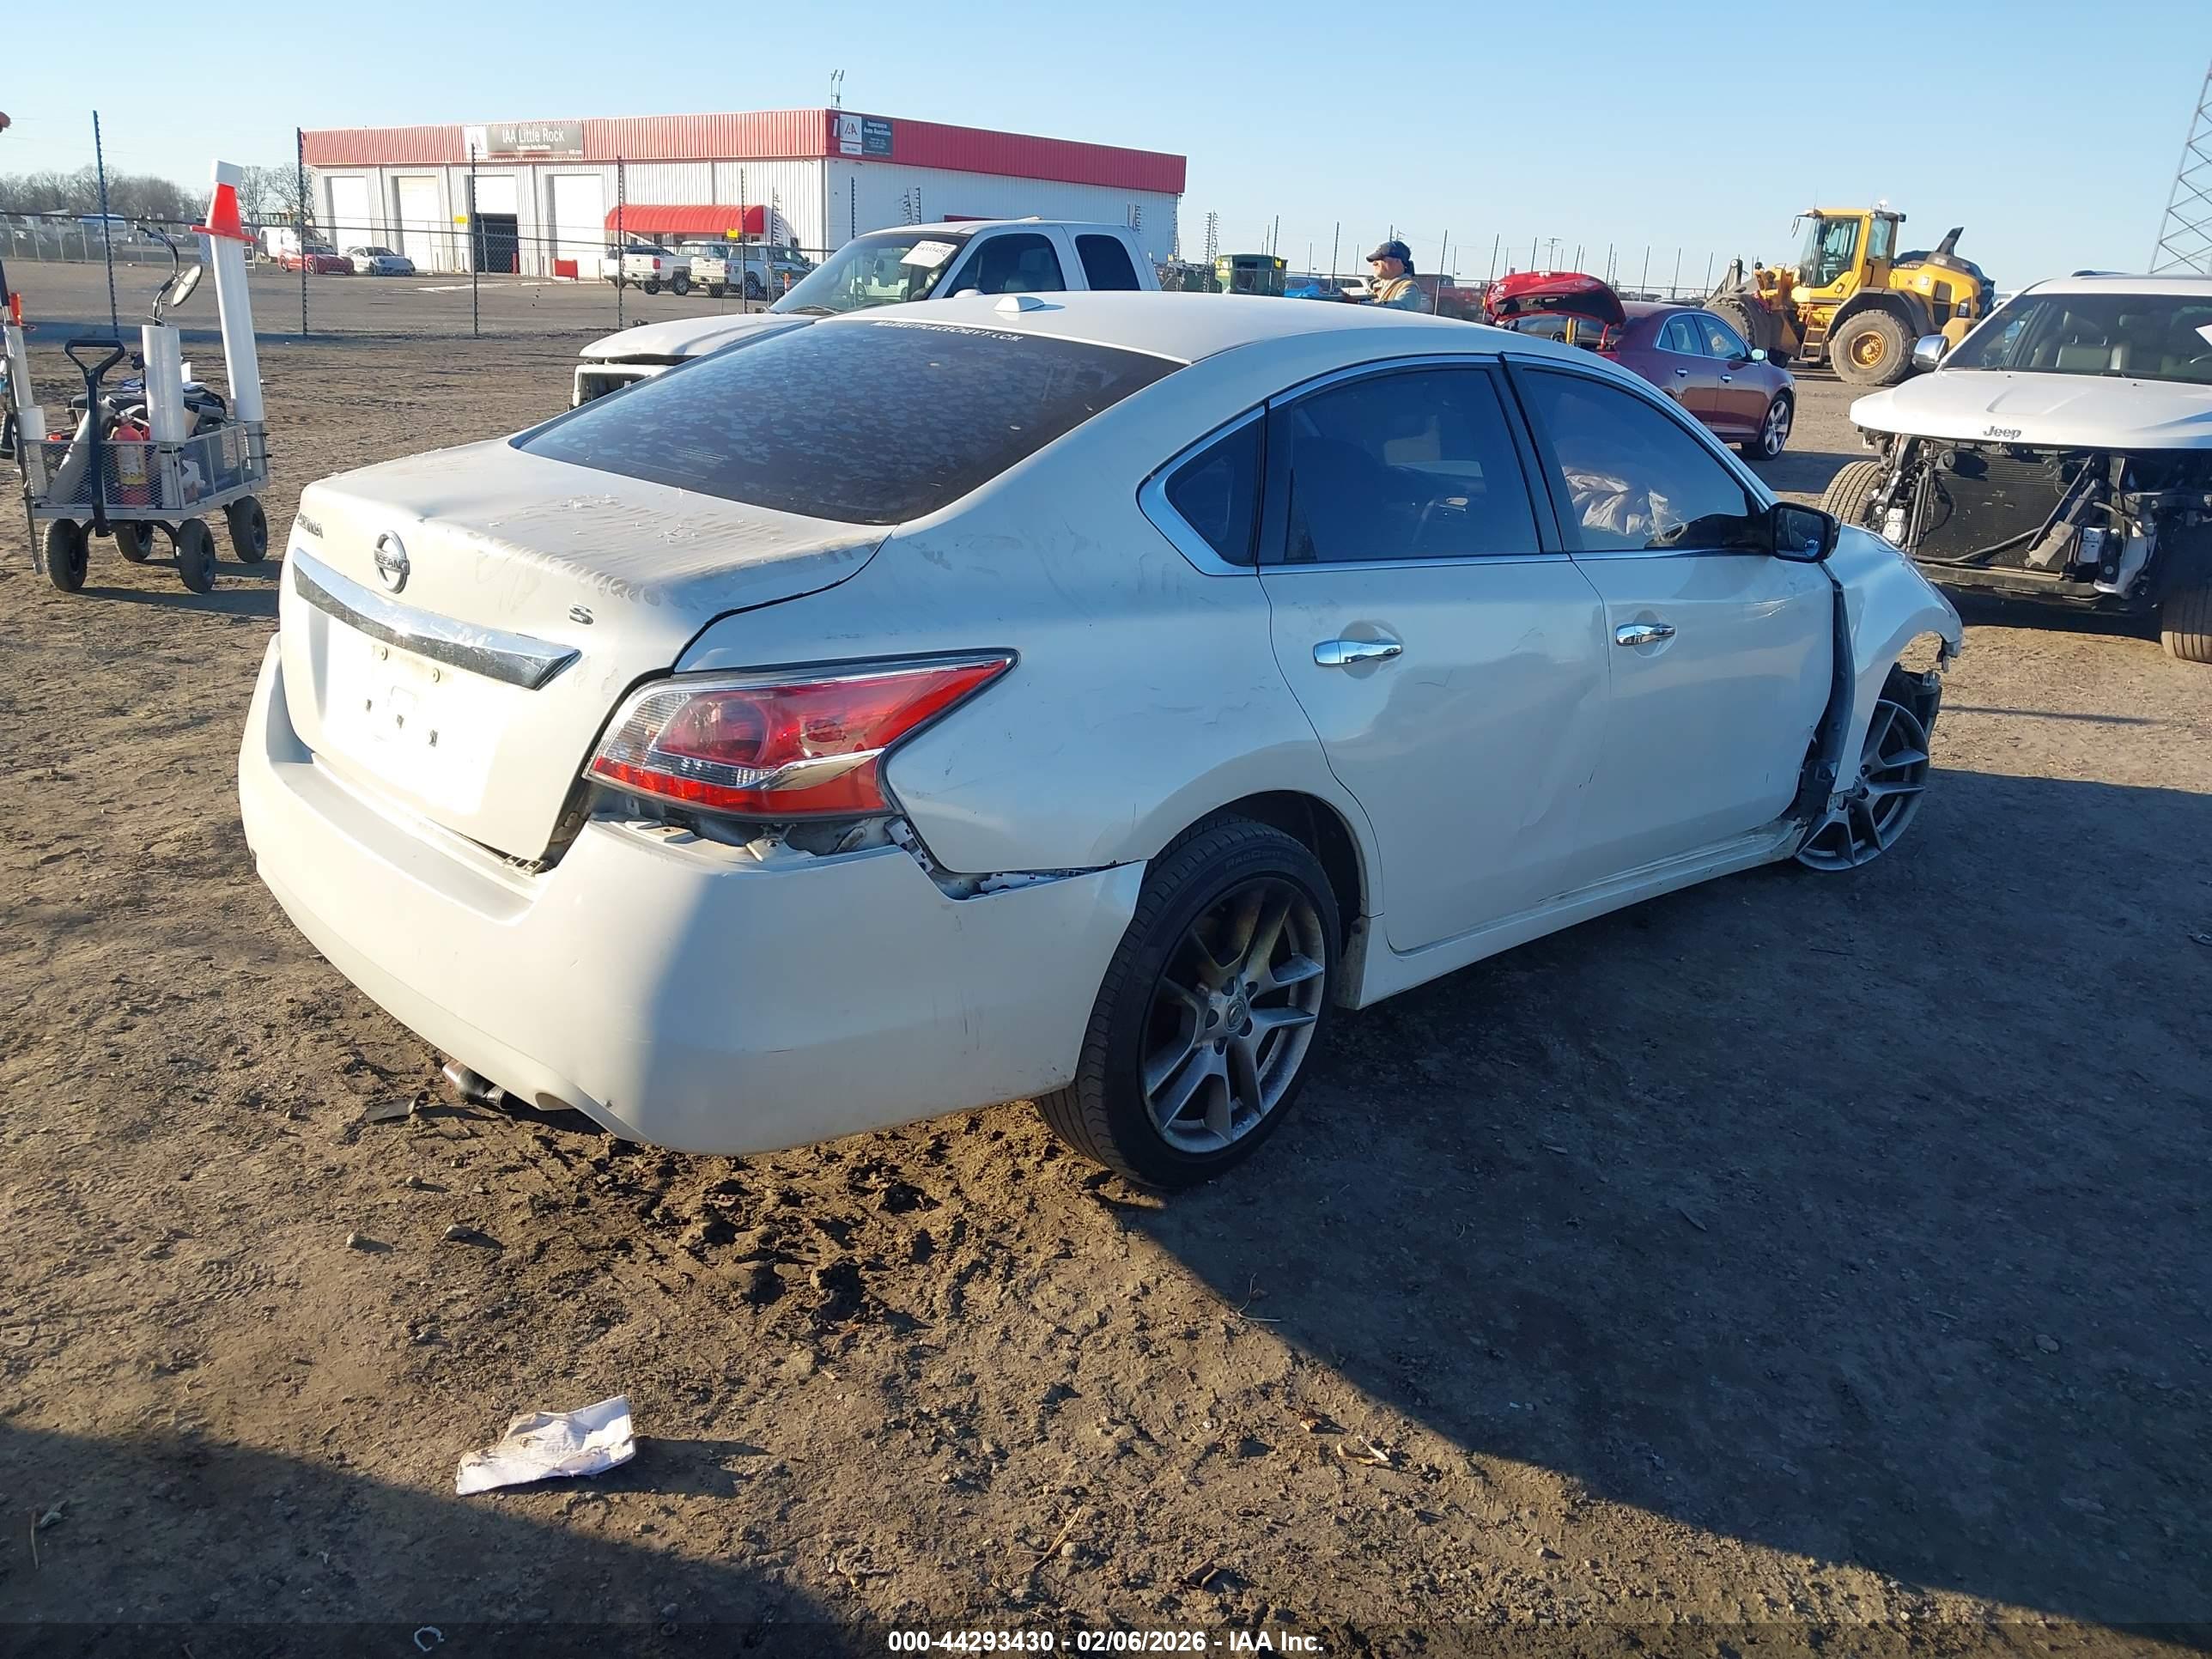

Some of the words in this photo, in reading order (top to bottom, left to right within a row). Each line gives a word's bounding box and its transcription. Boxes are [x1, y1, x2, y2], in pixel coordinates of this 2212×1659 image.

[501, 129, 517, 144] IAA
[518, 128, 540, 143] Little
[542, 127, 565, 143] Rock
[1983, 425, 2022, 441] Jeep
[568, 604, 594, 626] S
